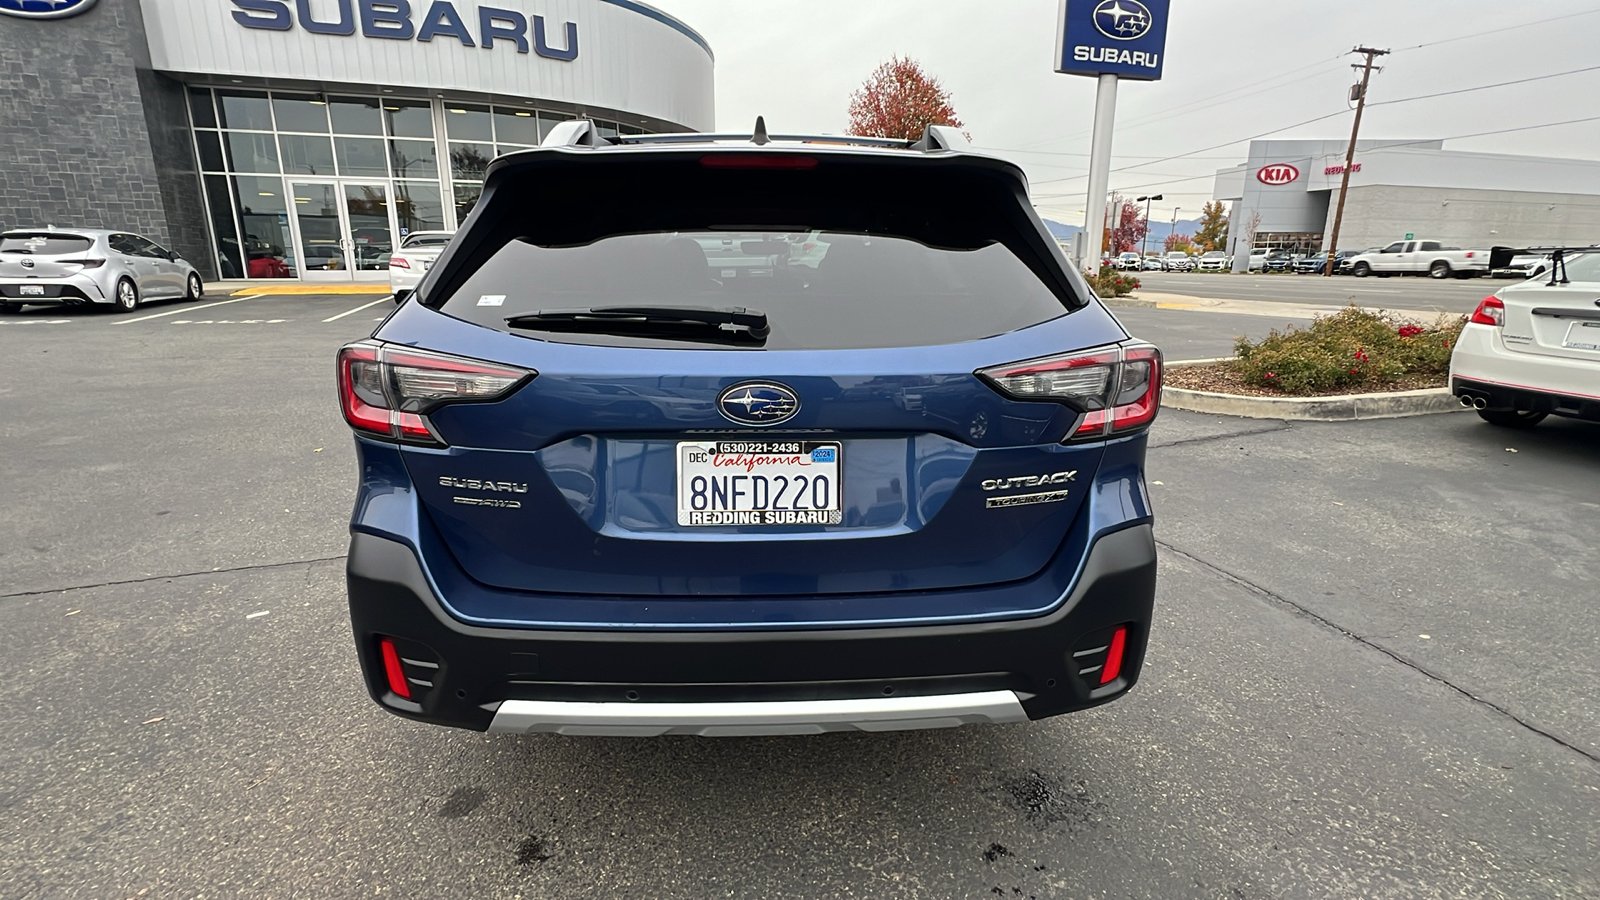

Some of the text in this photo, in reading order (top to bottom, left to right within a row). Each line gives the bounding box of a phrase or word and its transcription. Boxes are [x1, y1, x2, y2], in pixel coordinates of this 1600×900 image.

[230, 0, 579, 62] SUBARU
[1073, 45, 1158, 68] SUBARU
[1264, 168, 1292, 181] KIA
[1325, 163, 1362, 175] REDNG
[719, 442, 800, 454] (530)221-2436
[815, 450, 831, 458] 2024
[689, 452, 708, 463] DEC
[712, 453, 812, 473] California
[439, 476, 528, 494] SUBARU
[981, 470, 1078, 491] OUTBACK
[690, 475, 829, 510] 8NFD220
[691, 511, 828, 525] REDDING SUBARU
